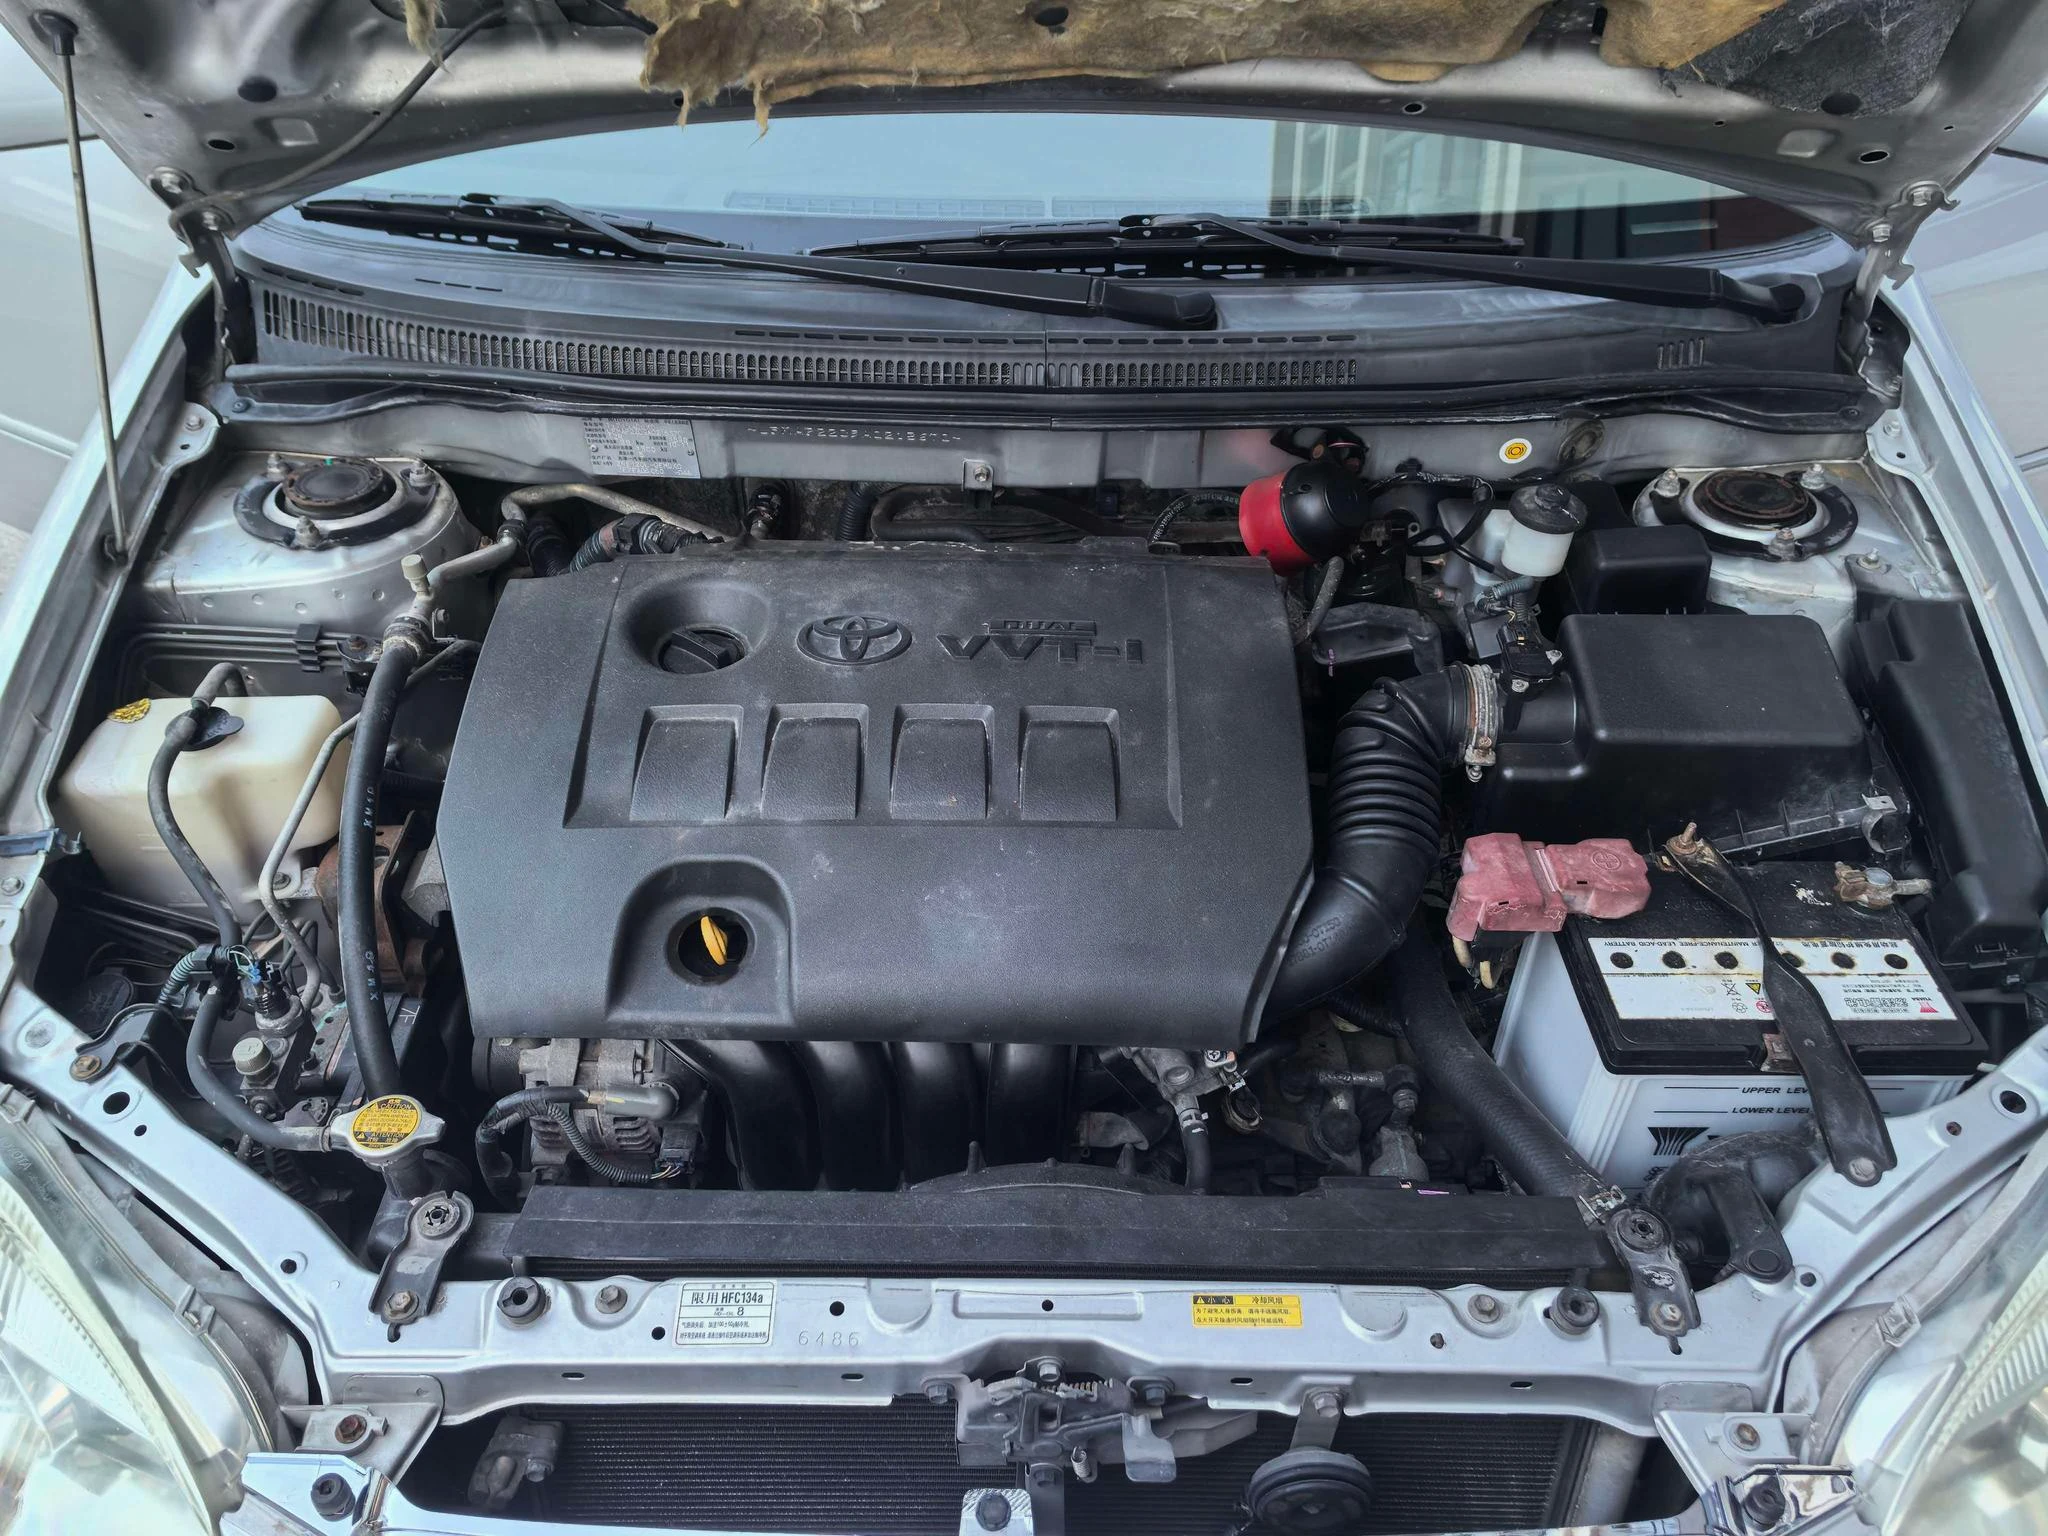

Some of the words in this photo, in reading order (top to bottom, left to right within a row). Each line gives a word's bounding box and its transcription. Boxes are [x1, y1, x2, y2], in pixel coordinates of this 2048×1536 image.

[1002, 619, 1094, 631] DUAL
[691, 1291, 718, 1304] 限用
[720, 1291, 764, 1304] HFC134a
[1251, 1296, 1283, 1305] 冷却风扇
[736, 1306, 744, 1316] 8
[798, 1330, 861, 1347] 6486
